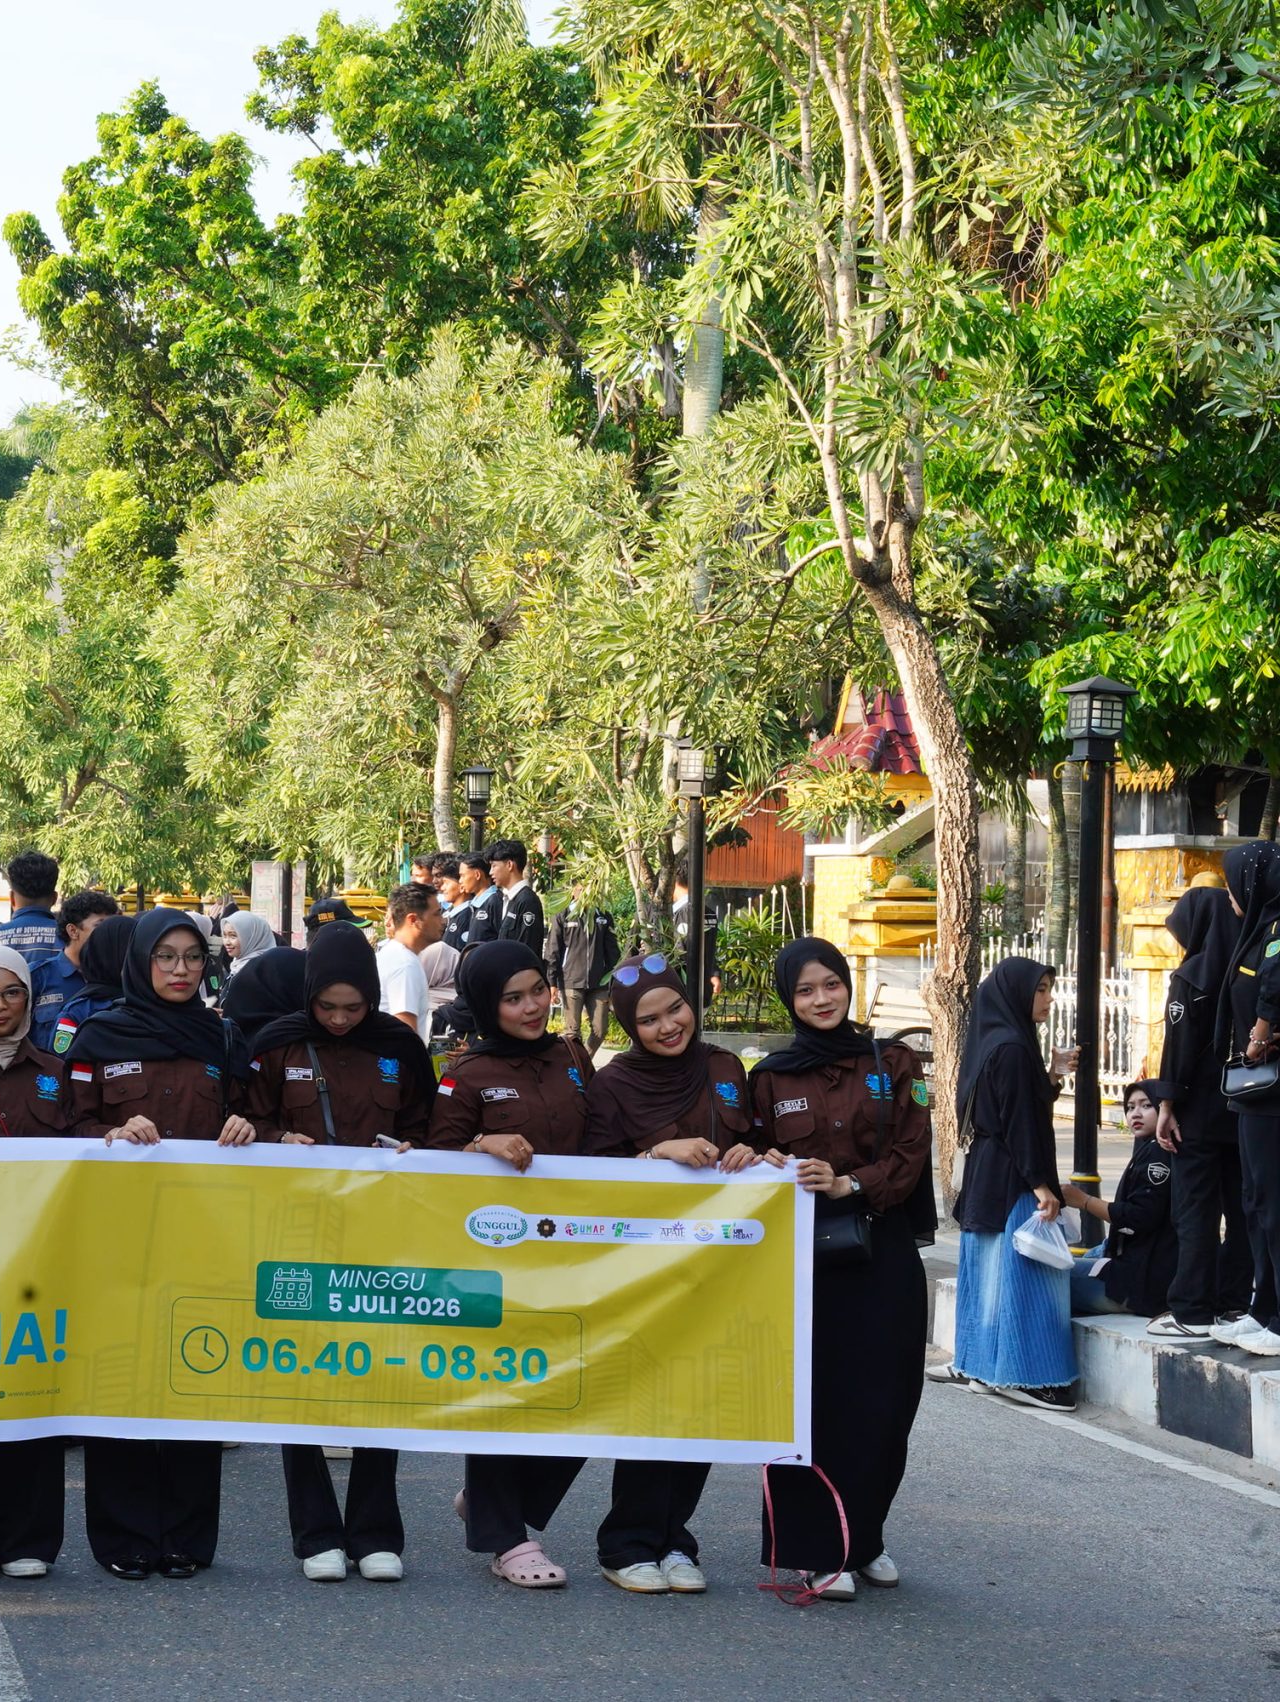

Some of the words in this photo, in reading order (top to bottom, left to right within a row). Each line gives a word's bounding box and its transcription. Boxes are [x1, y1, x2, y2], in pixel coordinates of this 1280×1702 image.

[476, 1221, 521, 1231] UNGGUL
[579, 1224, 605, 1233] UMAP
[328, 1269, 427, 1292] MINGGU
[328, 1293, 342, 1313] 5
[347, 1295, 398, 1316] JULI
[402, 1296, 462, 1318] 2026
[241, 1336, 372, 1377] 06.40
[420, 1343, 549, 1384] 08.30
